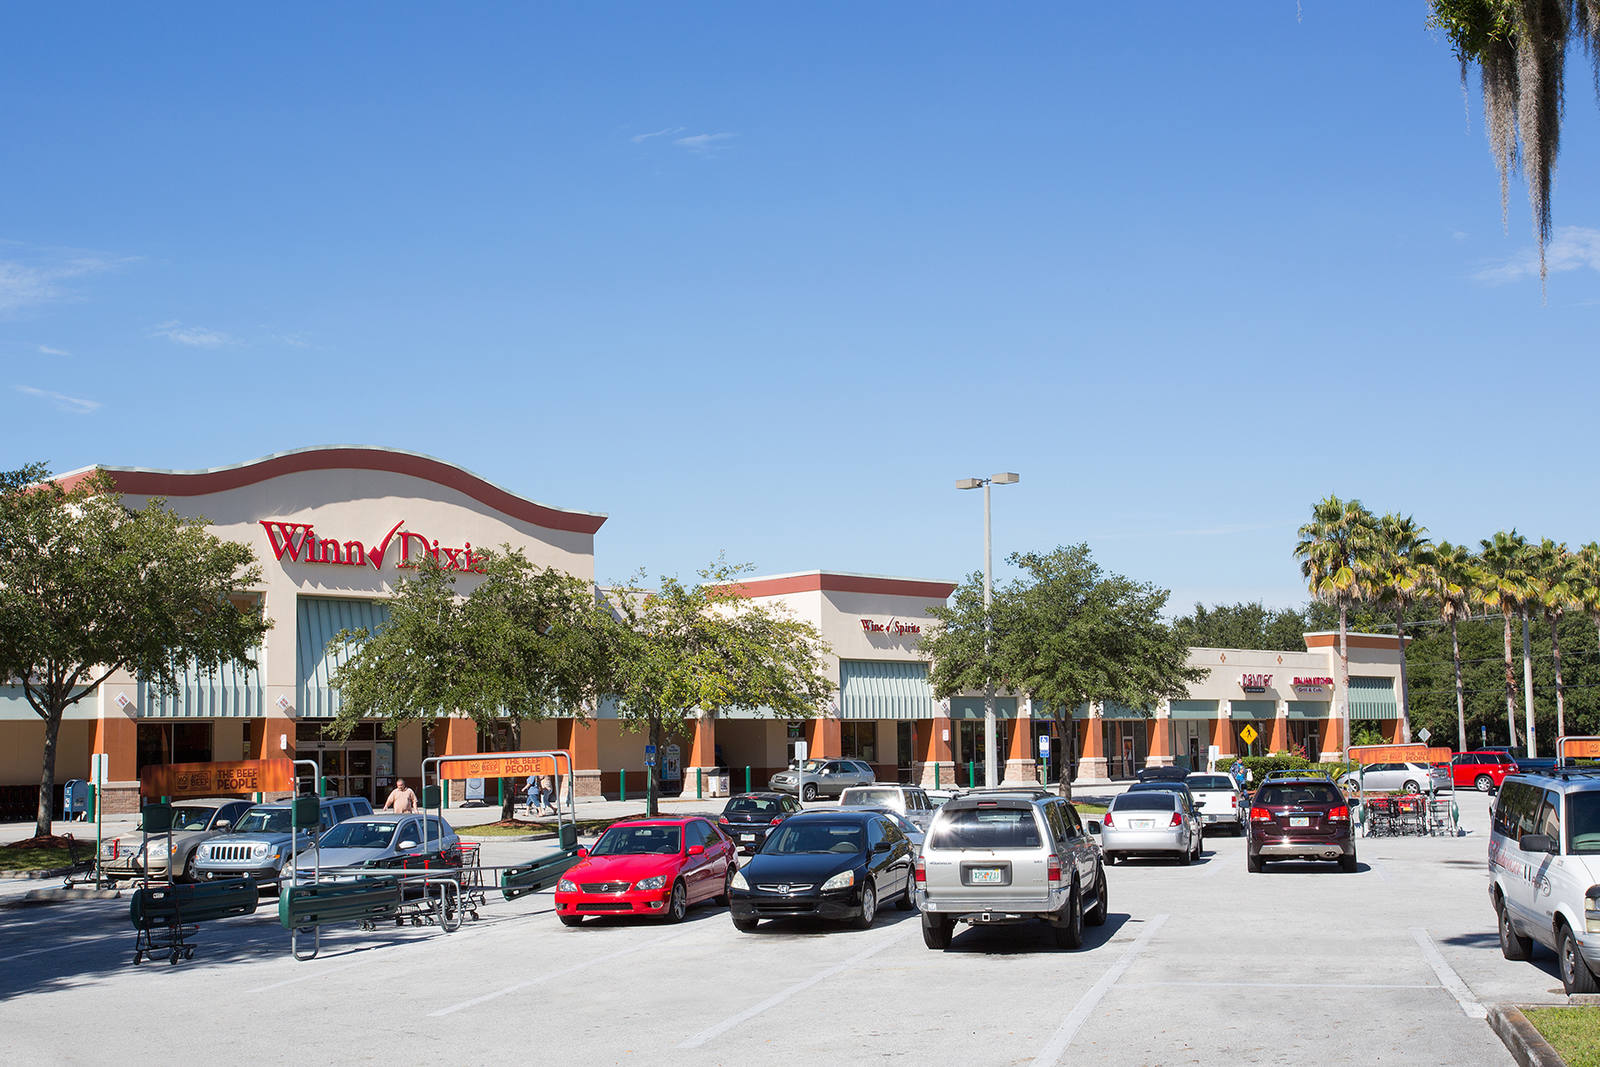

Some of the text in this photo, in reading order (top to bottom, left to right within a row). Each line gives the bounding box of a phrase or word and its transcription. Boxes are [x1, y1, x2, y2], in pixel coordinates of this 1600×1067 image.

[258, 520, 367, 566] Winn
[860, 619, 920, 636] Wine Spirits
[216, 769, 234, 779] THE
[236, 768, 258, 778] BEEF
[505, 763, 541, 774] PEOPLE
[216, 777, 258, 790] PEOPLE
